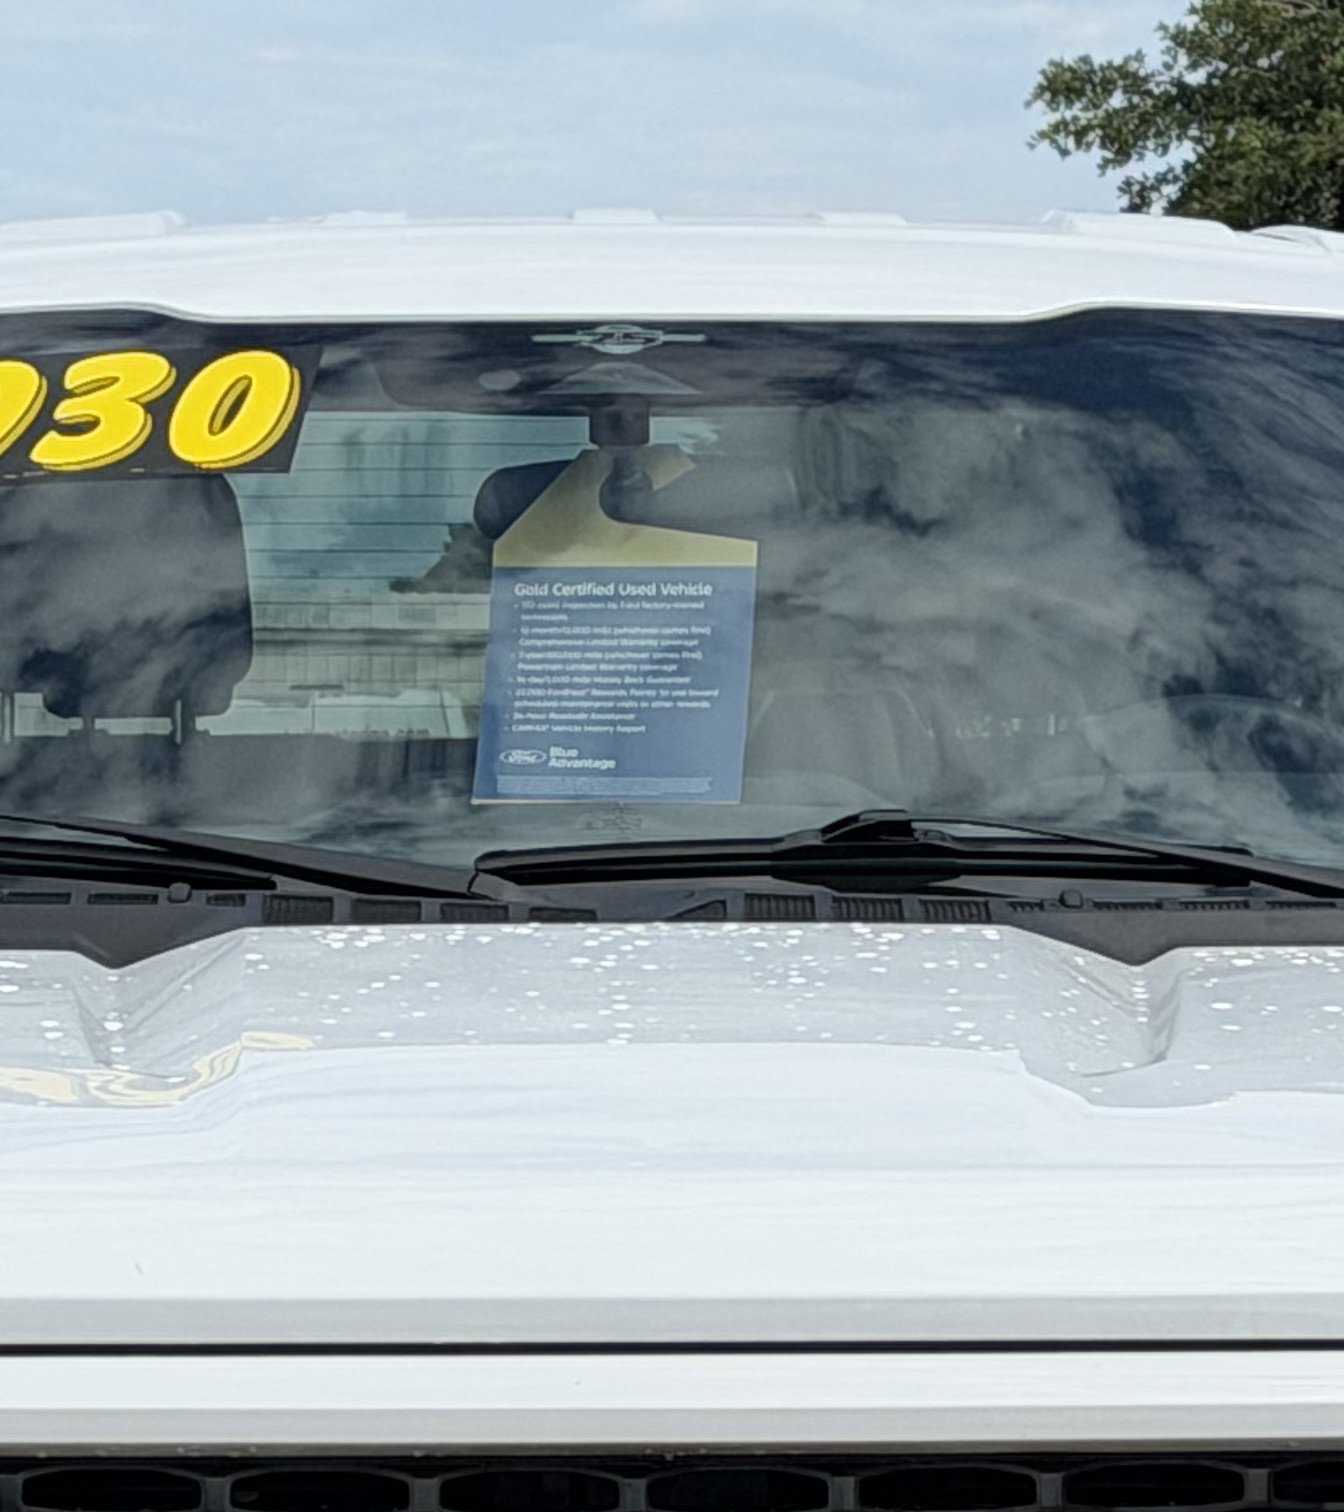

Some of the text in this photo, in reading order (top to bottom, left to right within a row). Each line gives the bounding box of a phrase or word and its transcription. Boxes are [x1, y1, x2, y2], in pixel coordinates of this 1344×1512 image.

[514, 582, 713, 596] Gold Certified Used Vehicle
[549, 746, 579, 757] Blue
[547, 758, 616, 770] Advantage
